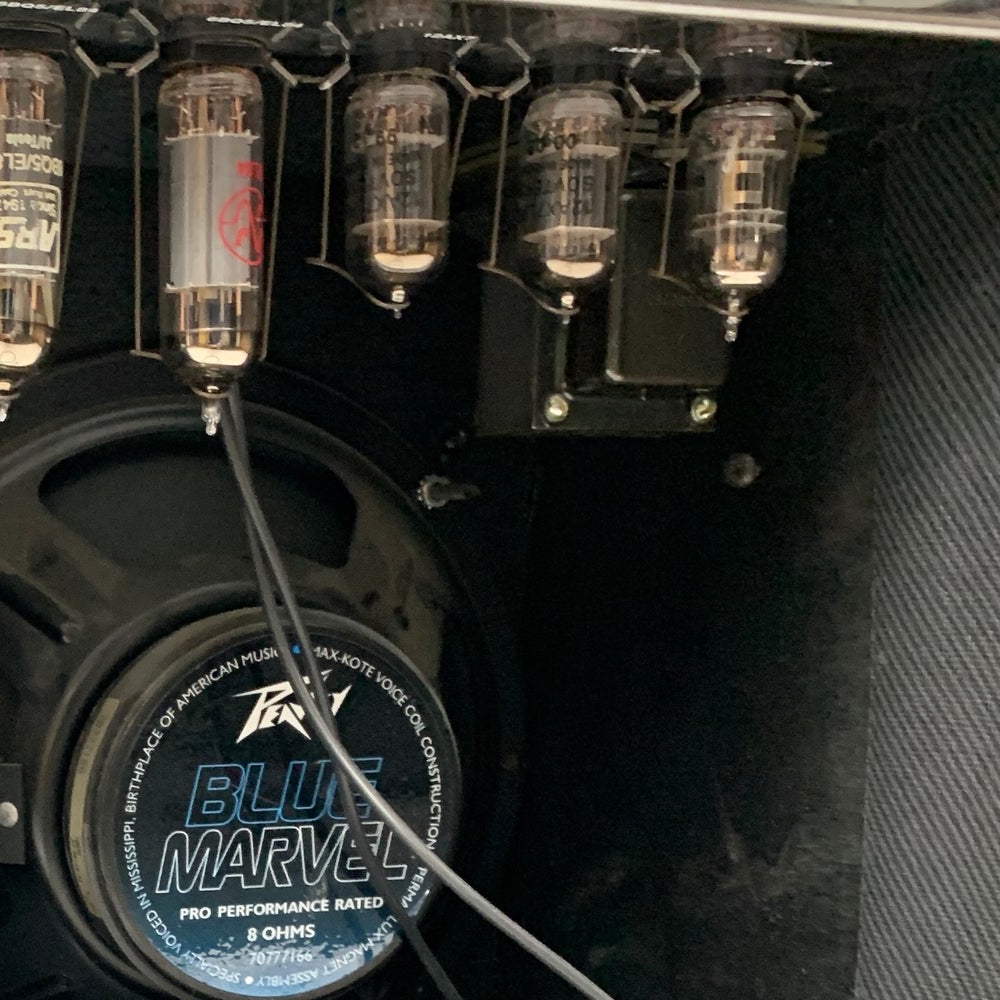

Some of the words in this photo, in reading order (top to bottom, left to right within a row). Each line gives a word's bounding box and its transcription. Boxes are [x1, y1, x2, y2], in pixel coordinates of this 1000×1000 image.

[125, 728, 164, 813] BIRTHPLACE
[159, 707, 177, 728] OF
[176, 658, 239, 711] AMERICAN
[375, 671, 408, 707] VOICE
[405, 704, 426, 737] COIL
[420, 736, 442, 850] CONSTRUCTION
[185, 757, 384, 828] BLUE
[123, 816, 144, 893] MISSISSIPPI,
[155, 821, 408, 894] MARVEL
[137, 893, 152, 910] IN
[179, 907, 212, 921] PRO
[217, 898, 330, 918] PERFORMANCE
[334, 896, 384, 912] RATED
[145, 910, 182, 953] VOICED
[246, 927, 258, 942] 8
[262, 924, 316, 941] OHMS
[372, 914, 398, 941] LUX
[181, 949, 241, 984] SPECIALLY
[249, 950, 313, 966] 70777166
[323, 937, 375, 970] MAGNET
[256, 967, 319, 987] ASSEMBLY
